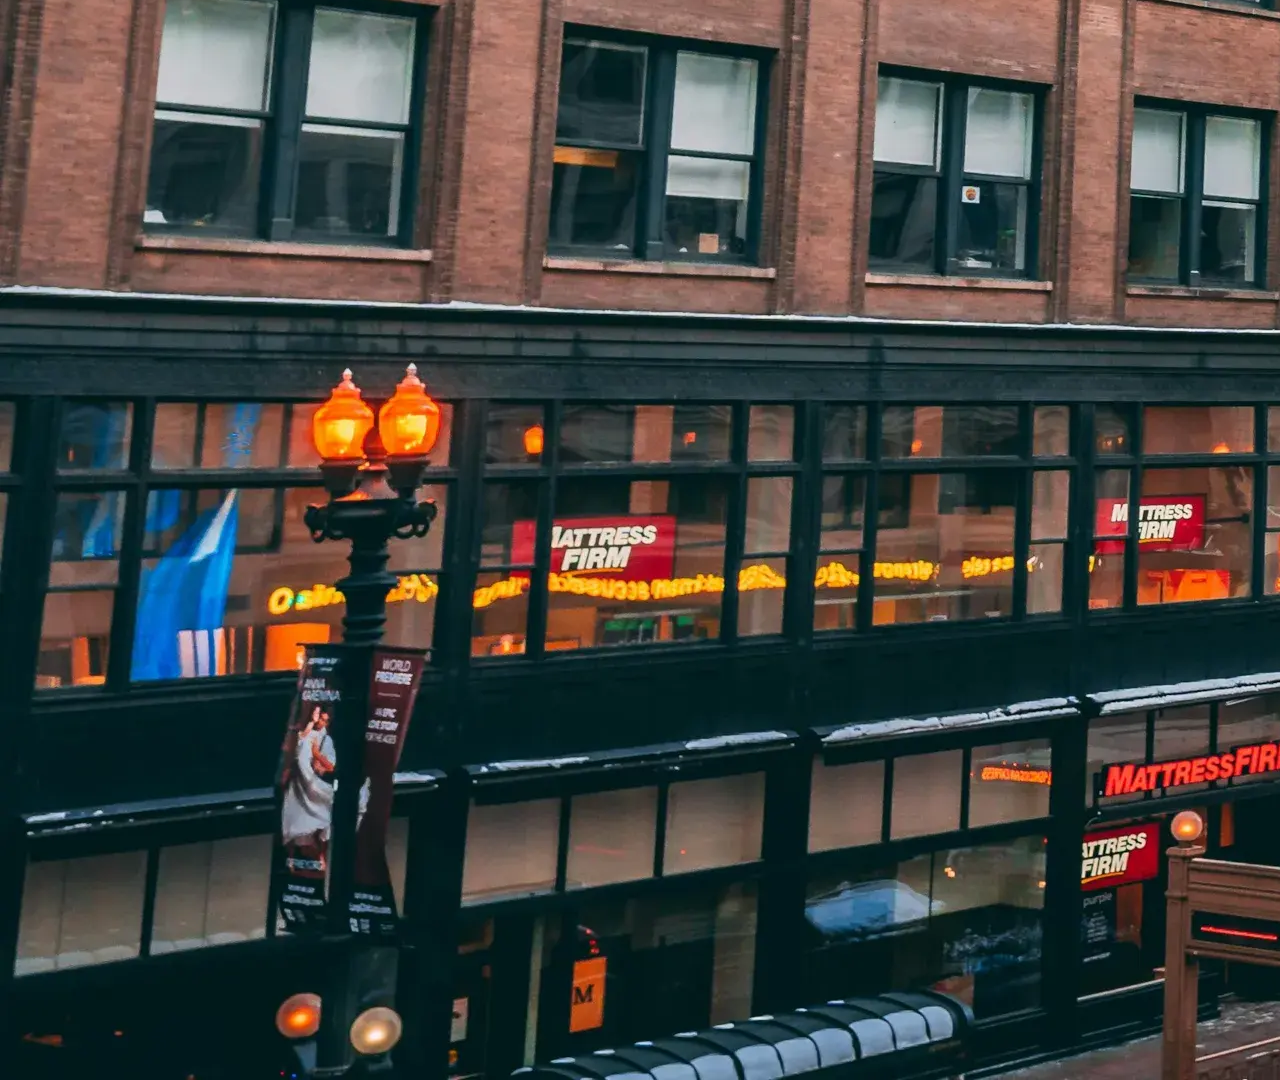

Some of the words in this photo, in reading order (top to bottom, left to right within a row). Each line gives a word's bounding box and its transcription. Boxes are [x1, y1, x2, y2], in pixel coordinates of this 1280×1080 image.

[1111, 504, 1193, 522] MTTRESS
[561, 546, 631, 571] FIRM
[1081, 852, 1129, 878] FIRM
[573, 984, 594, 1006] M
